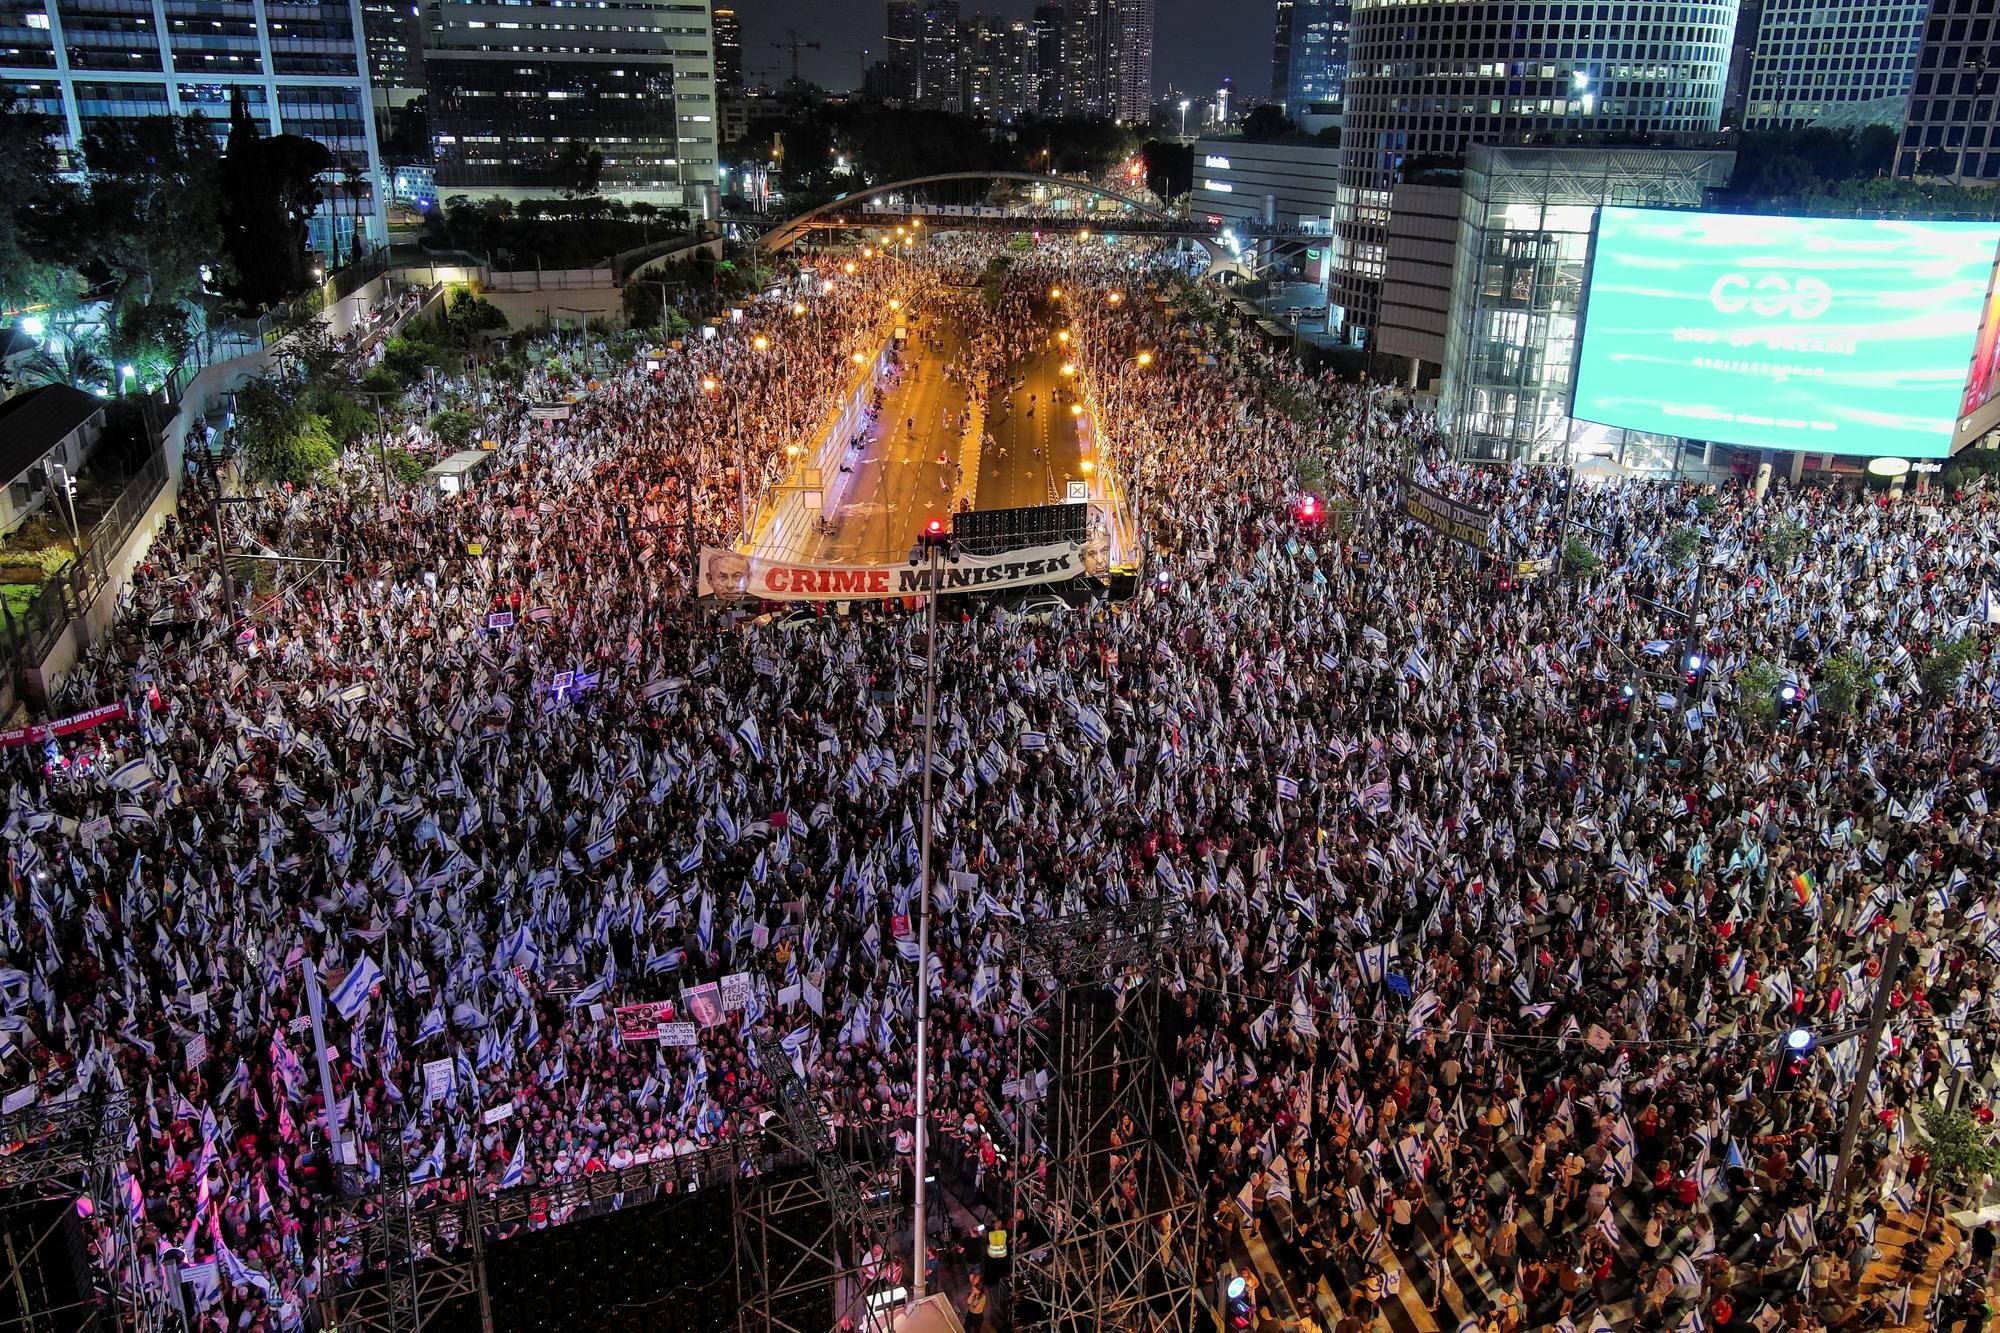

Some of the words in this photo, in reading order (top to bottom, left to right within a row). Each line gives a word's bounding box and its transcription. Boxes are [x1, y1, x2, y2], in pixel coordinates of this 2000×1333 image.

[1912, 463, 1942, 473] Digital
[765, 568, 889, 593] CRIME
[899, 554, 1071, 592] MINISTER
[693, 983, 716, 993] ESCOBAR
